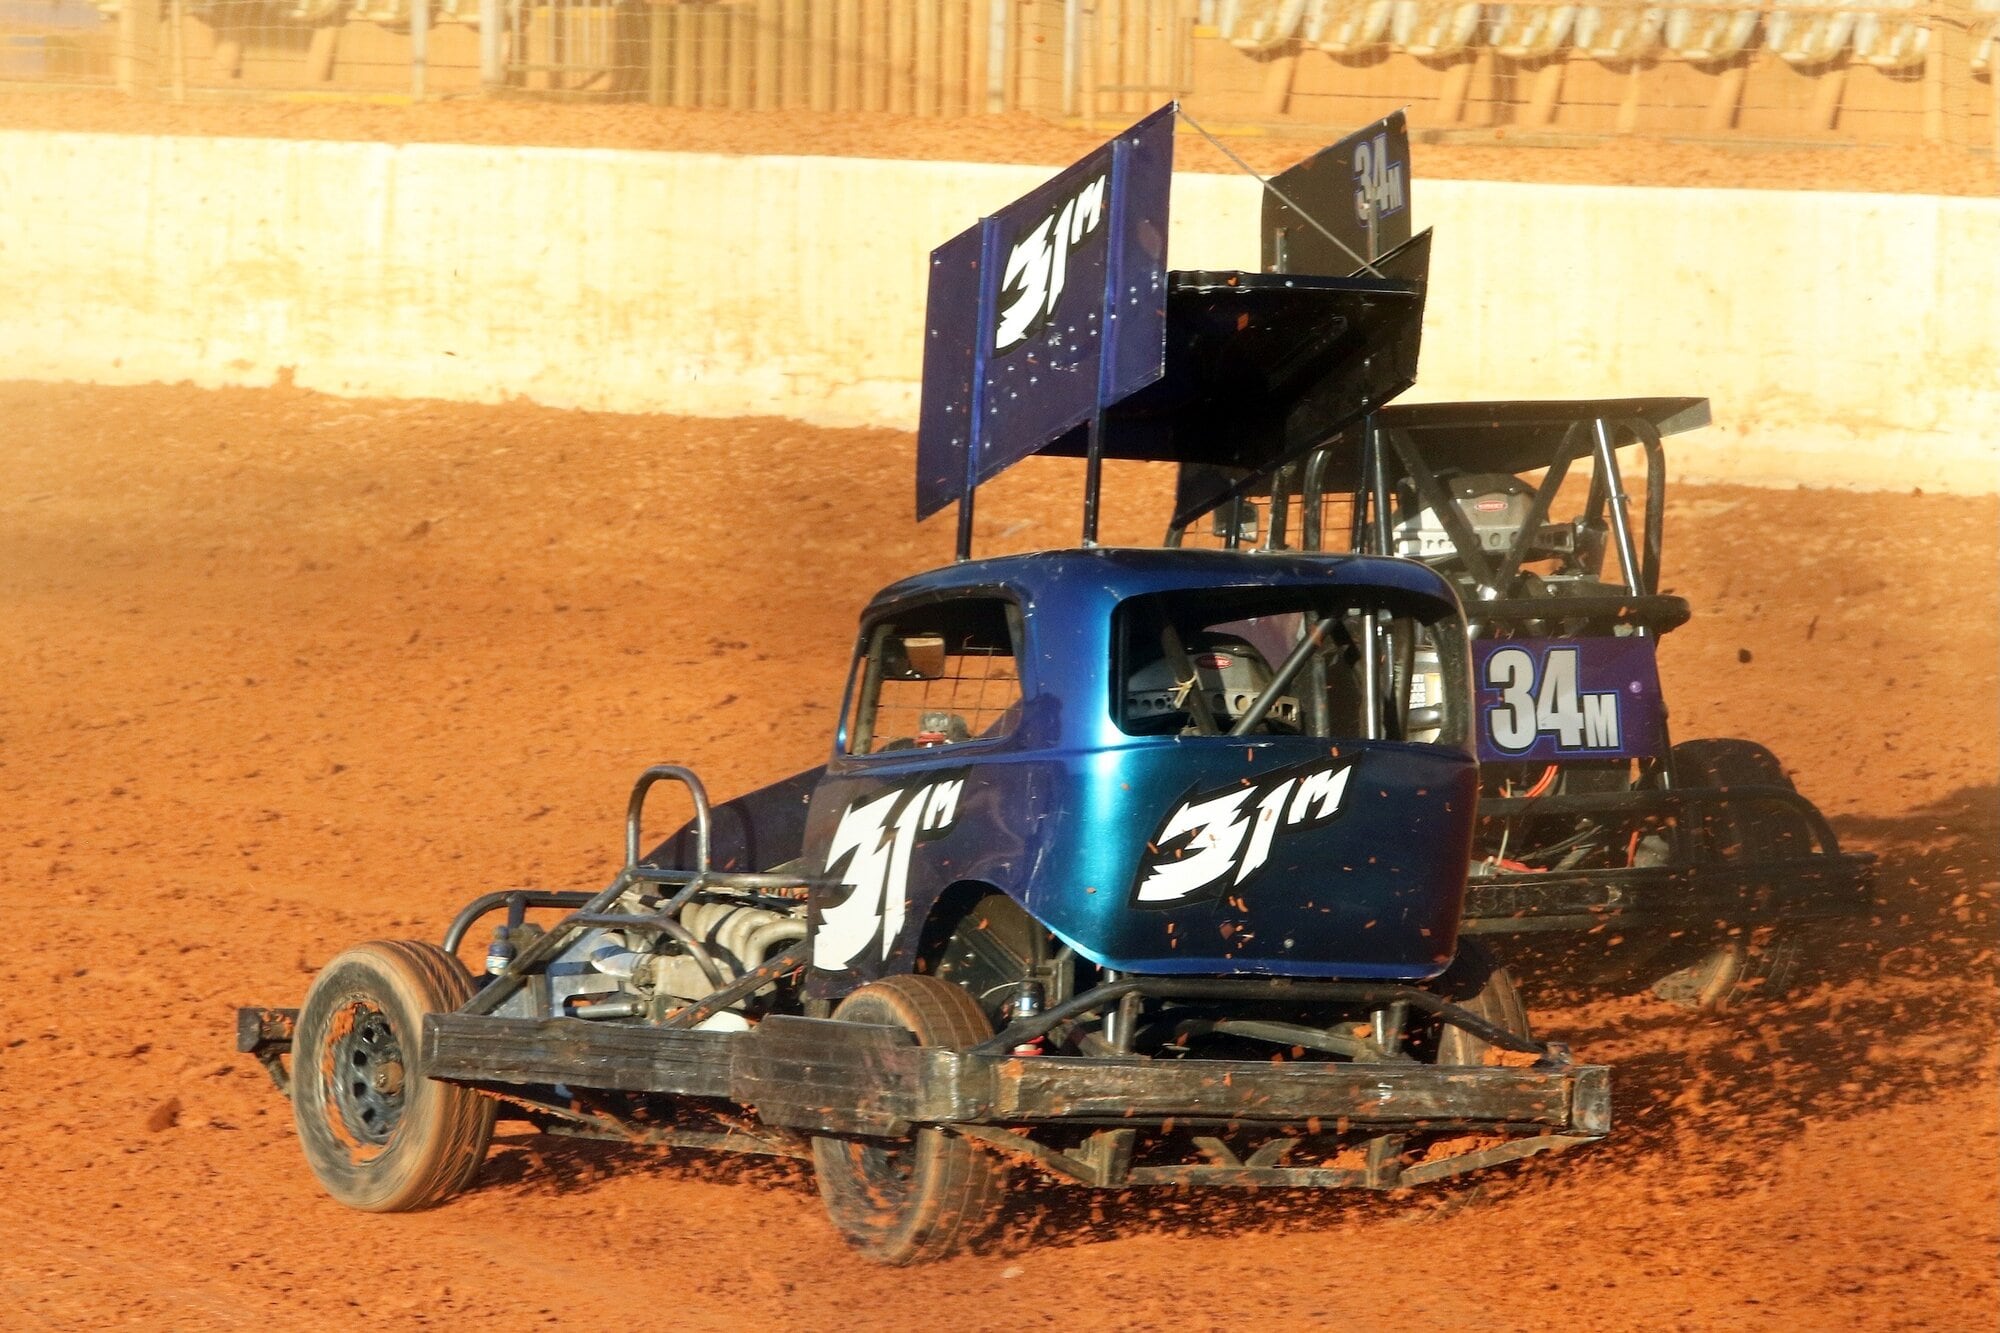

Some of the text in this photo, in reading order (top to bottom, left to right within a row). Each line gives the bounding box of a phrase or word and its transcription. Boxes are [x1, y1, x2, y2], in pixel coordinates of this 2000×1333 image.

[1354, 134, 1403, 221] 34M
[996, 175, 1106, 349] 31M
[1489, 649, 1619, 749] 34M
[813, 779, 964, 971] 31M
[1137, 765, 1352, 902] 31M
